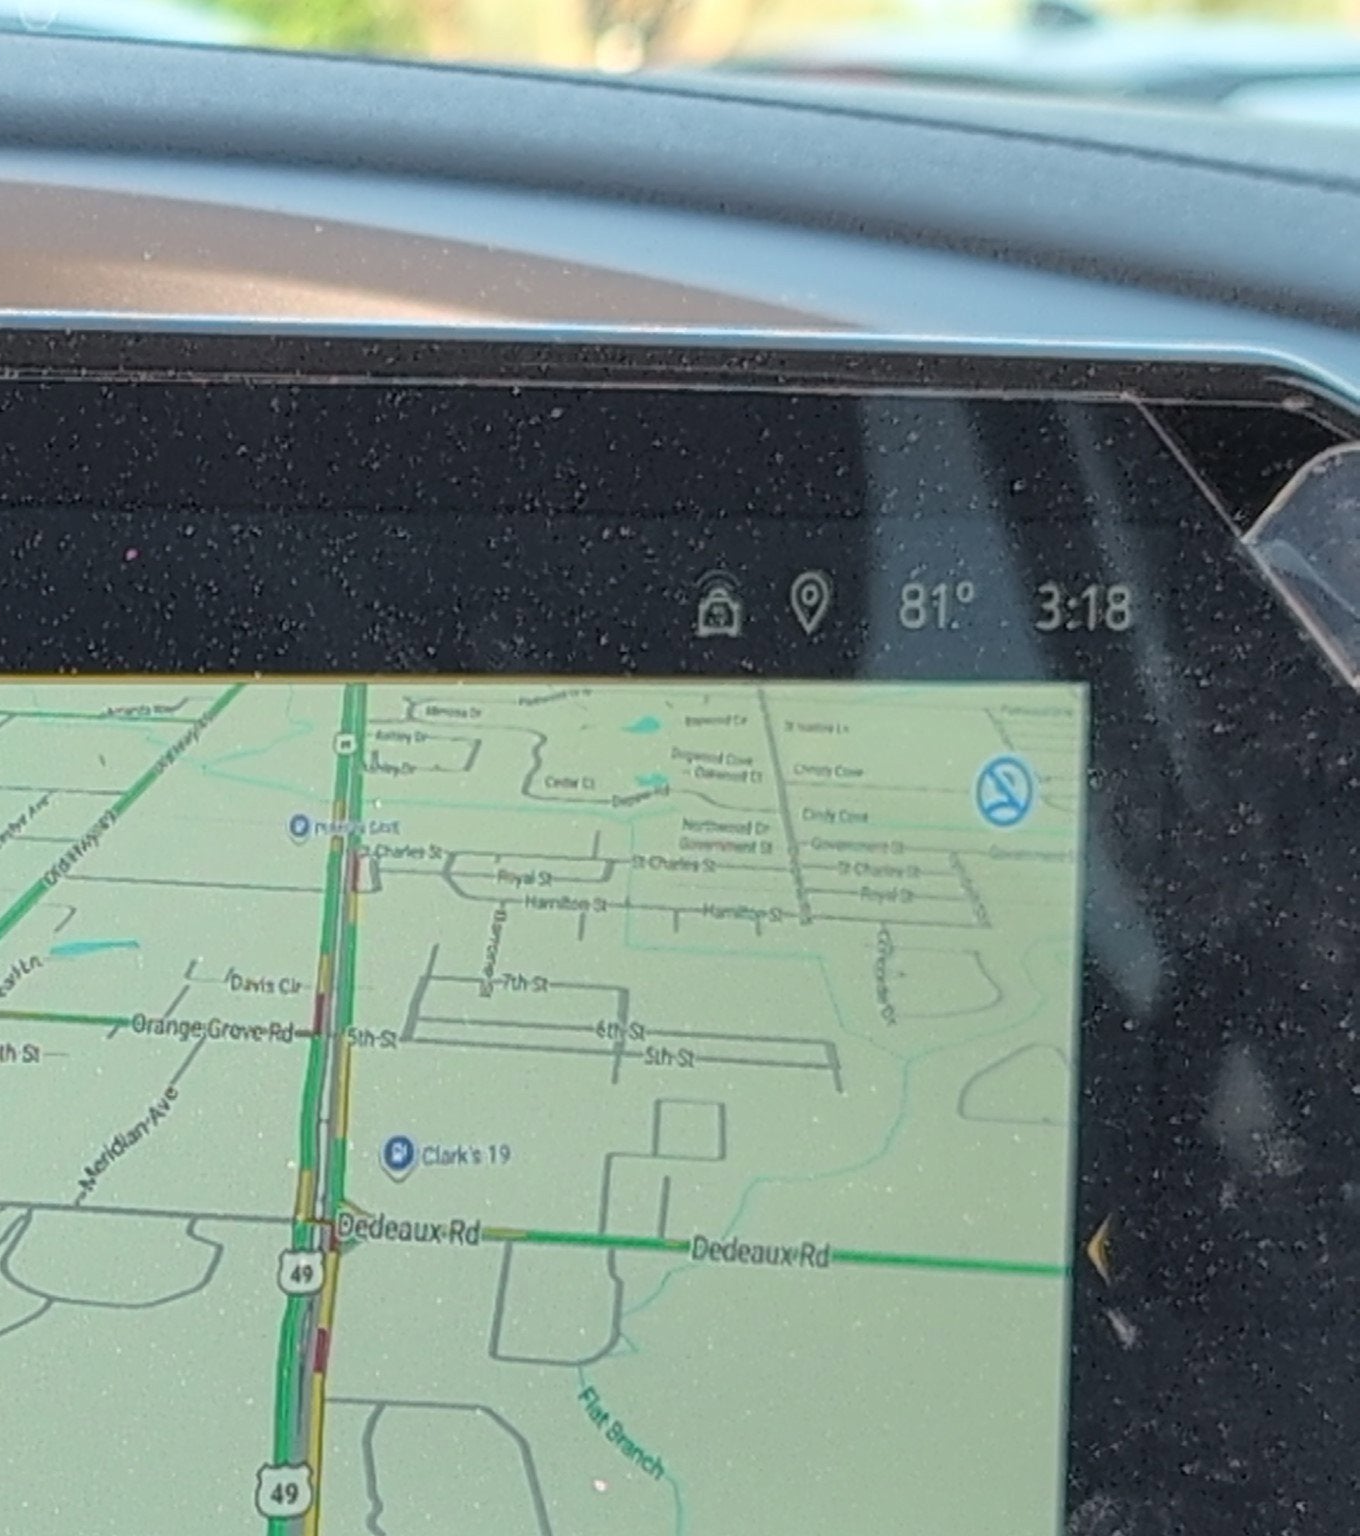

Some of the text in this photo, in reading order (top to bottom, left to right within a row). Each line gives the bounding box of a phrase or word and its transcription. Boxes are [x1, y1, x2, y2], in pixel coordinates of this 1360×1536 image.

[899, 581, 974, 629] 81°
[1036, 580, 1132, 630] 3:18
[524, 894, 588, 911] Hamilton
[230, 972, 275, 994] Davis
[501, 971, 549, 994] 7th St
[131, 1012, 294, 1044] Orange Grove Rd
[379, 1028, 397, 1049] St
[595, 1020, 646, 1041] 6th St
[21, 1043, 41, 1065] St
[643, 1046, 696, 1069] 5th St
[77, 1084, 179, 1195] Meridian Ave
[422, 1143, 511, 1166] Clark's 19
[337, 1211, 482, 1247] Dedeaux Rd
[691, 1233, 830, 1269] Dedeaux Rd
[289, 1263, 315, 1285] 49
[577, 1385, 665, 1481] Flat Branch
[269, 1481, 299, 1506] 49
